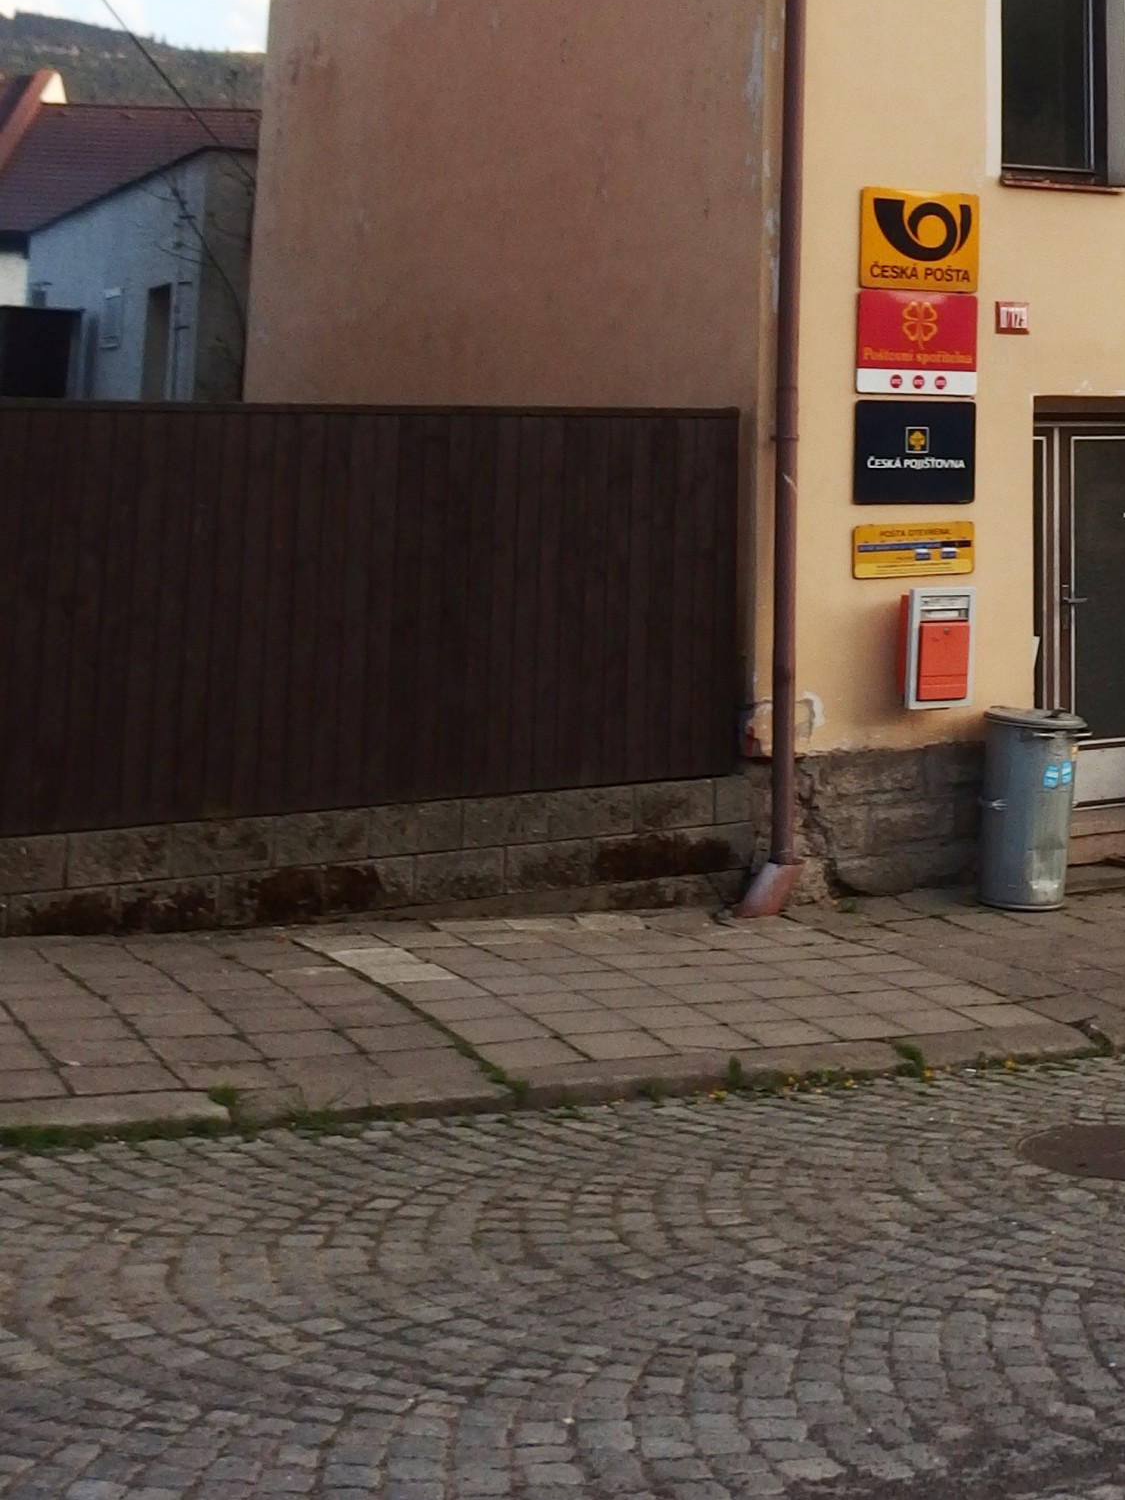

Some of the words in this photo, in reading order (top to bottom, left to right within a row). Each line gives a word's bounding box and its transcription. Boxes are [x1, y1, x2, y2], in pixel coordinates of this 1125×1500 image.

[869, 261, 918, 280] ČESKÁ
[923, 265, 971, 283] POŠTA
[867, 455, 901, 469] ČESKÁ
